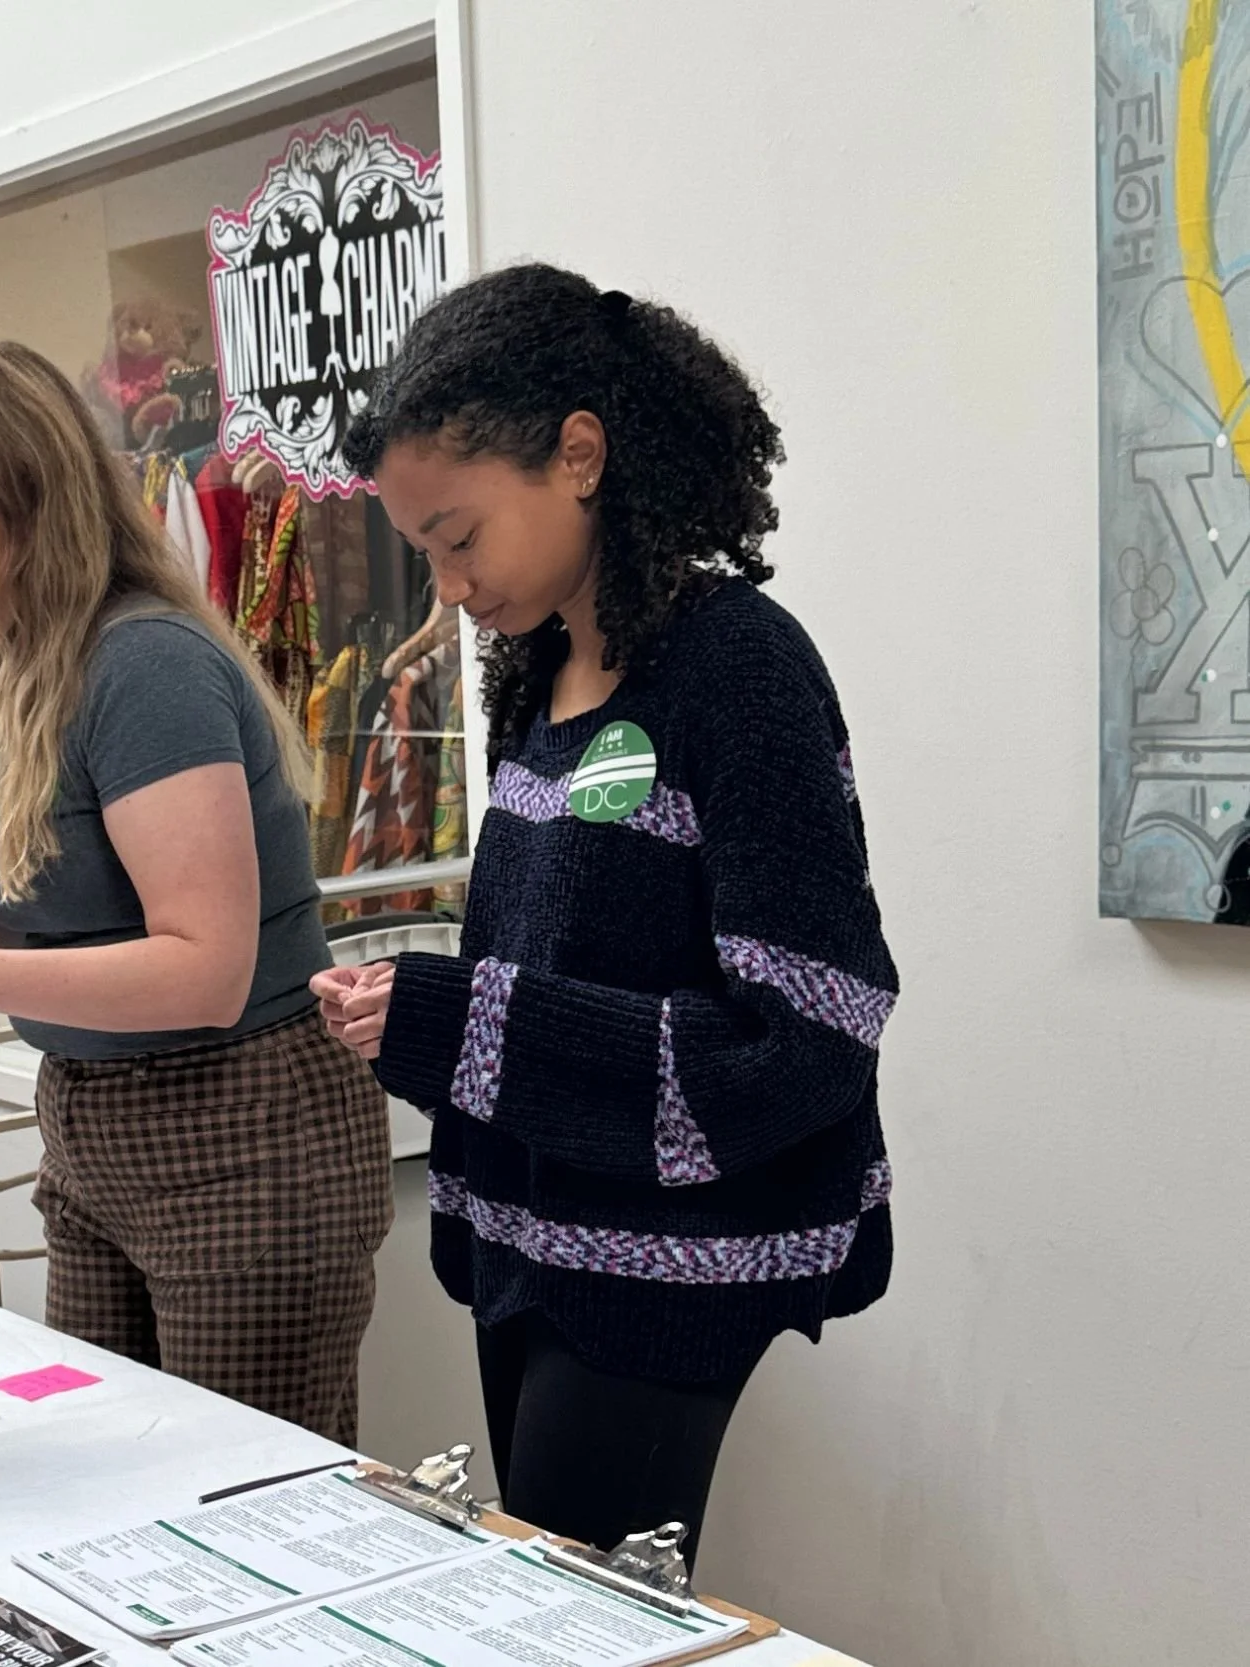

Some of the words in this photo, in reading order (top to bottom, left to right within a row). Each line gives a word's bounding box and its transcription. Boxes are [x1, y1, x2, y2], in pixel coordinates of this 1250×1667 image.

[213, 253, 318, 402] VINTAGE
[606, 728, 624, 743] AM
[584, 782, 628, 813] DC
[4, 1640, 54, 1667] YOUR
